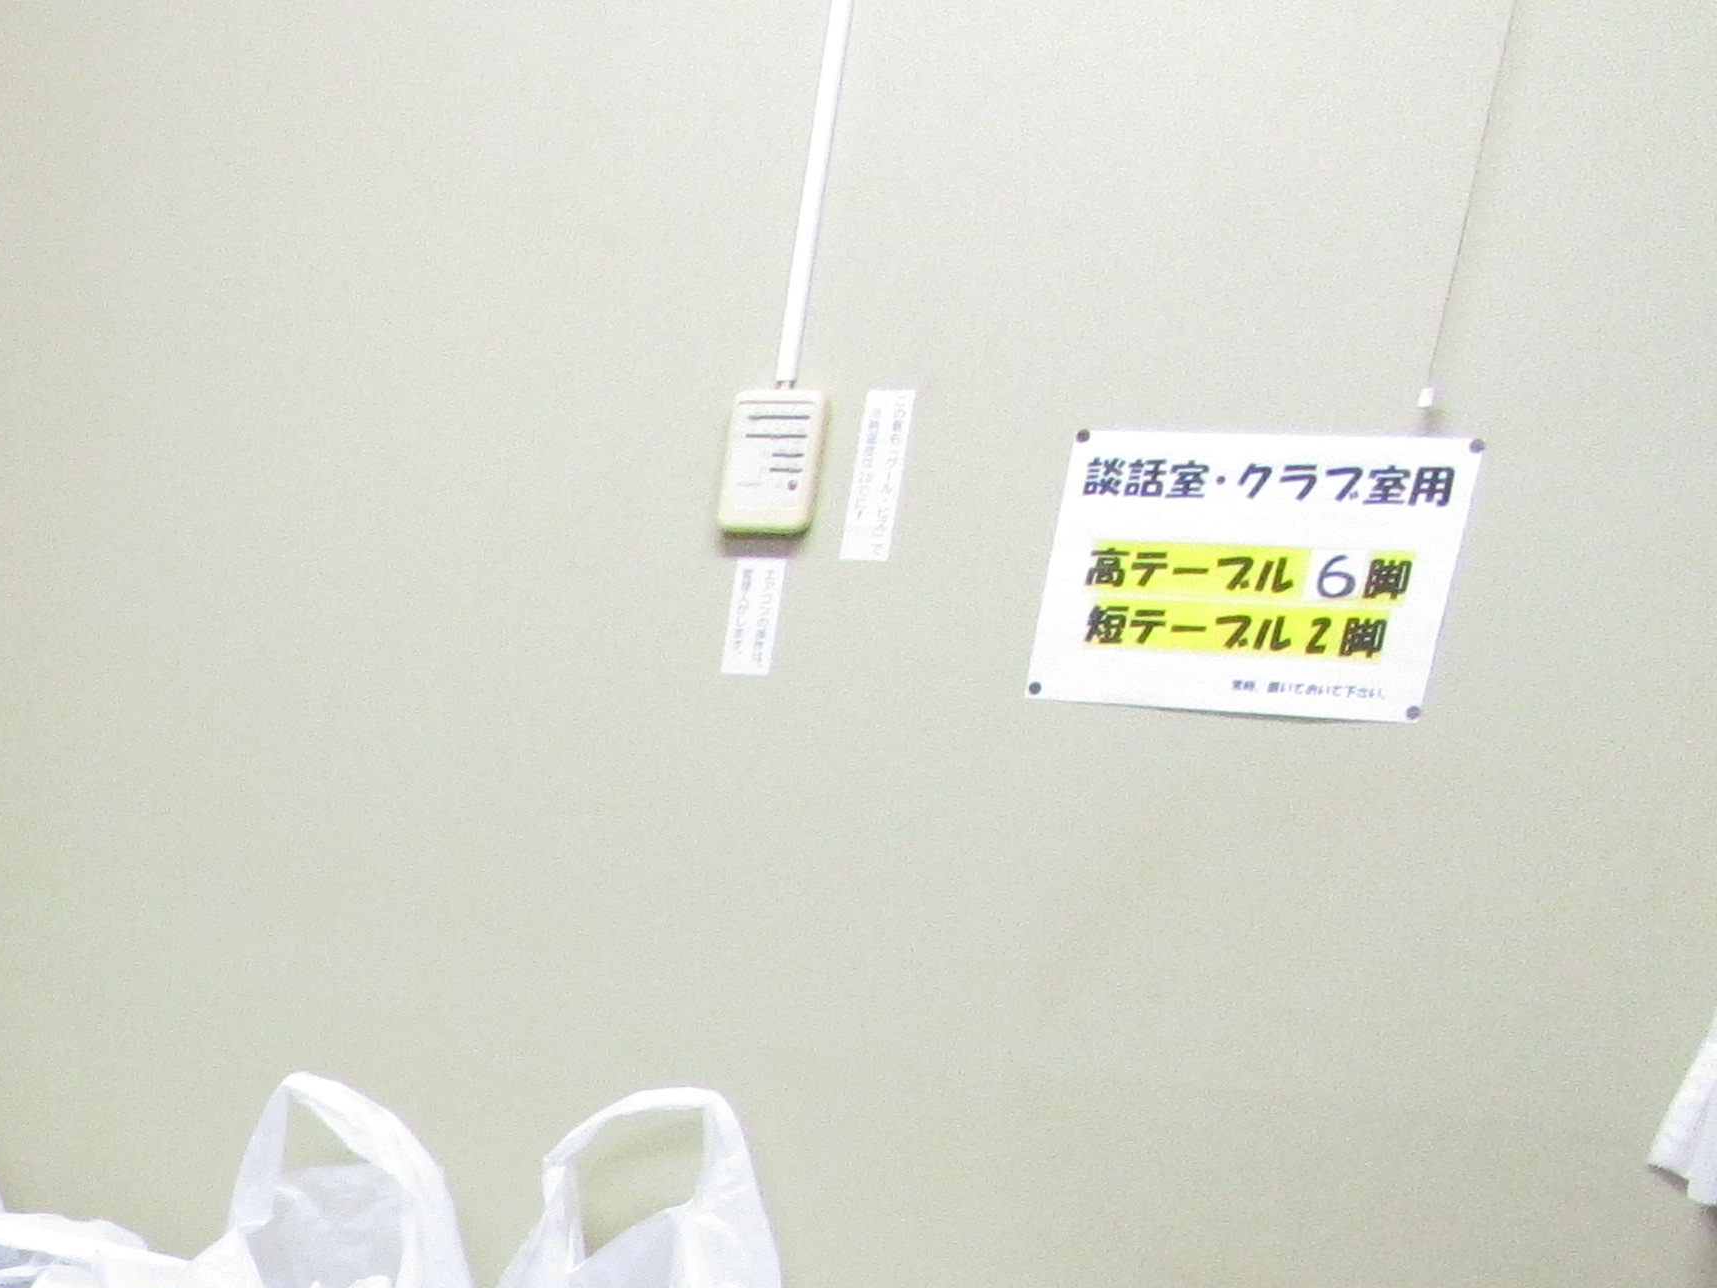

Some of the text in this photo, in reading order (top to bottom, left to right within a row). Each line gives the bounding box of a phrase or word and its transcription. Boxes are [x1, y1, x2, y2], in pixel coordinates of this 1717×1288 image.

[1082, 456, 1456, 507] 談話室・クラブ室用
